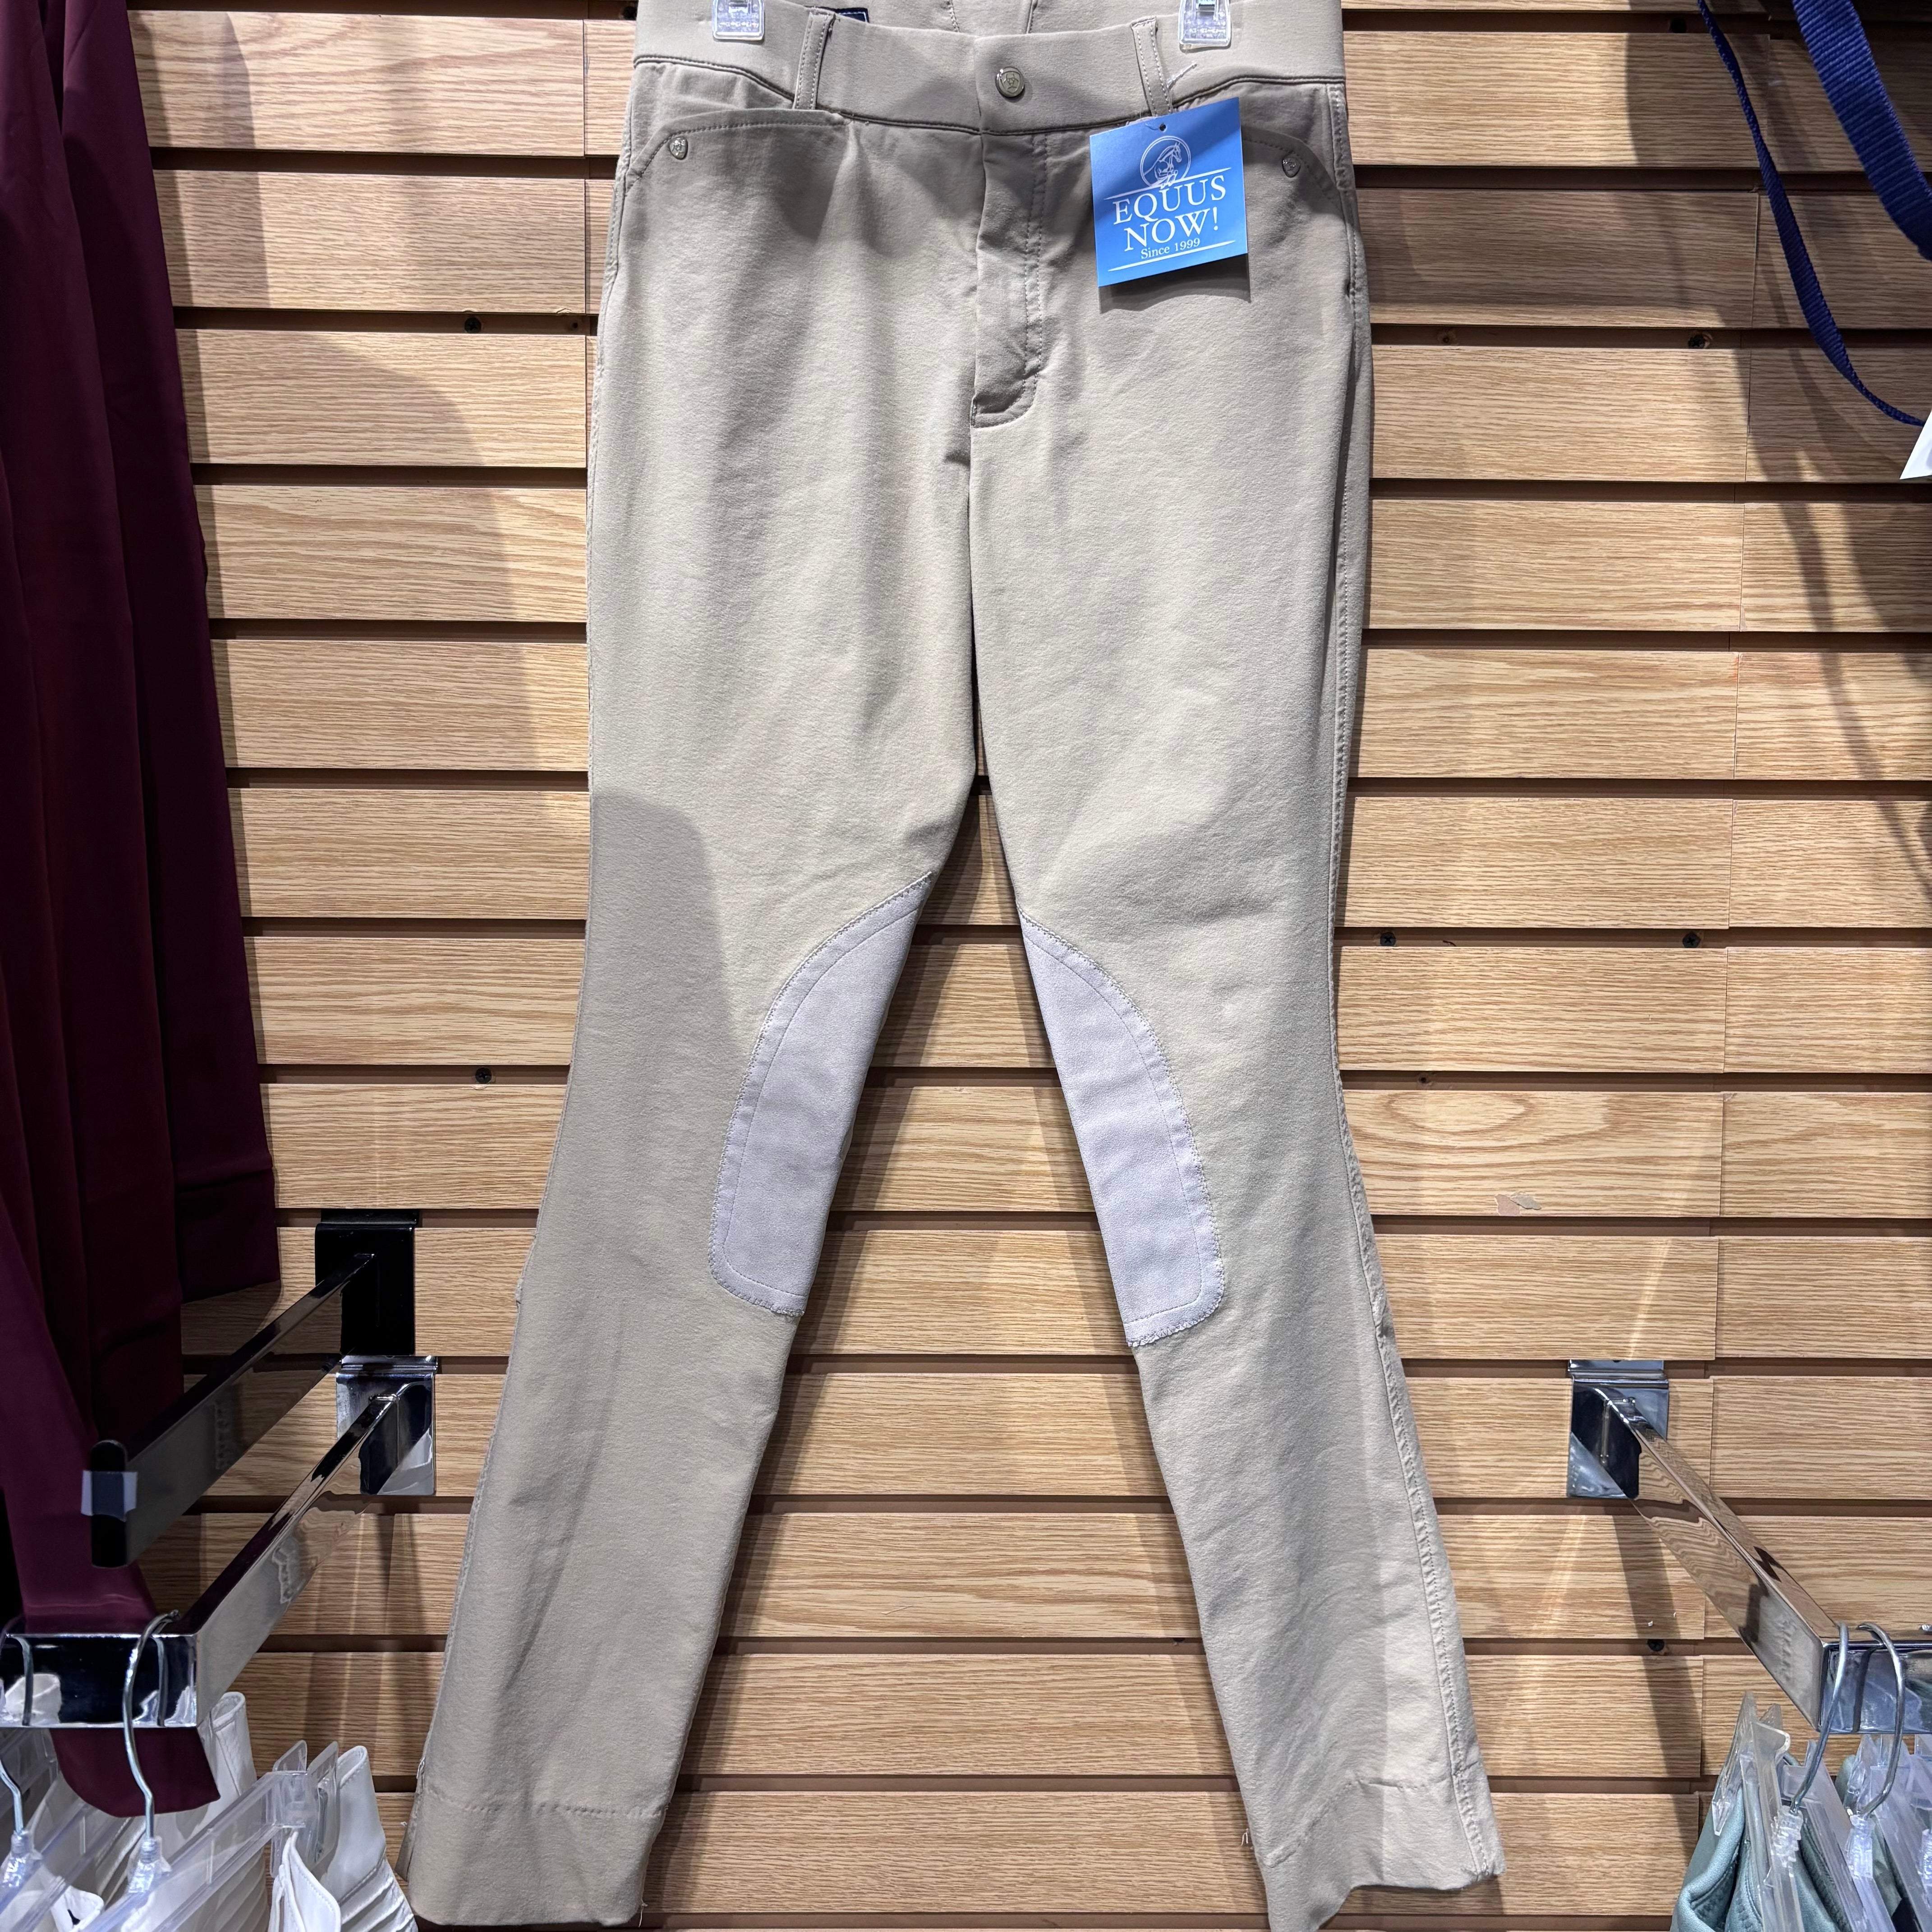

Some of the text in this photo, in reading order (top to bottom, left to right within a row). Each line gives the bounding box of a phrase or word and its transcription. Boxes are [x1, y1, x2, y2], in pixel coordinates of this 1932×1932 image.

[1113, 175, 1226, 225] EQUUS
[1124, 207, 1218, 251] NOW!
[1141, 238, 1201, 259] Since 1999
